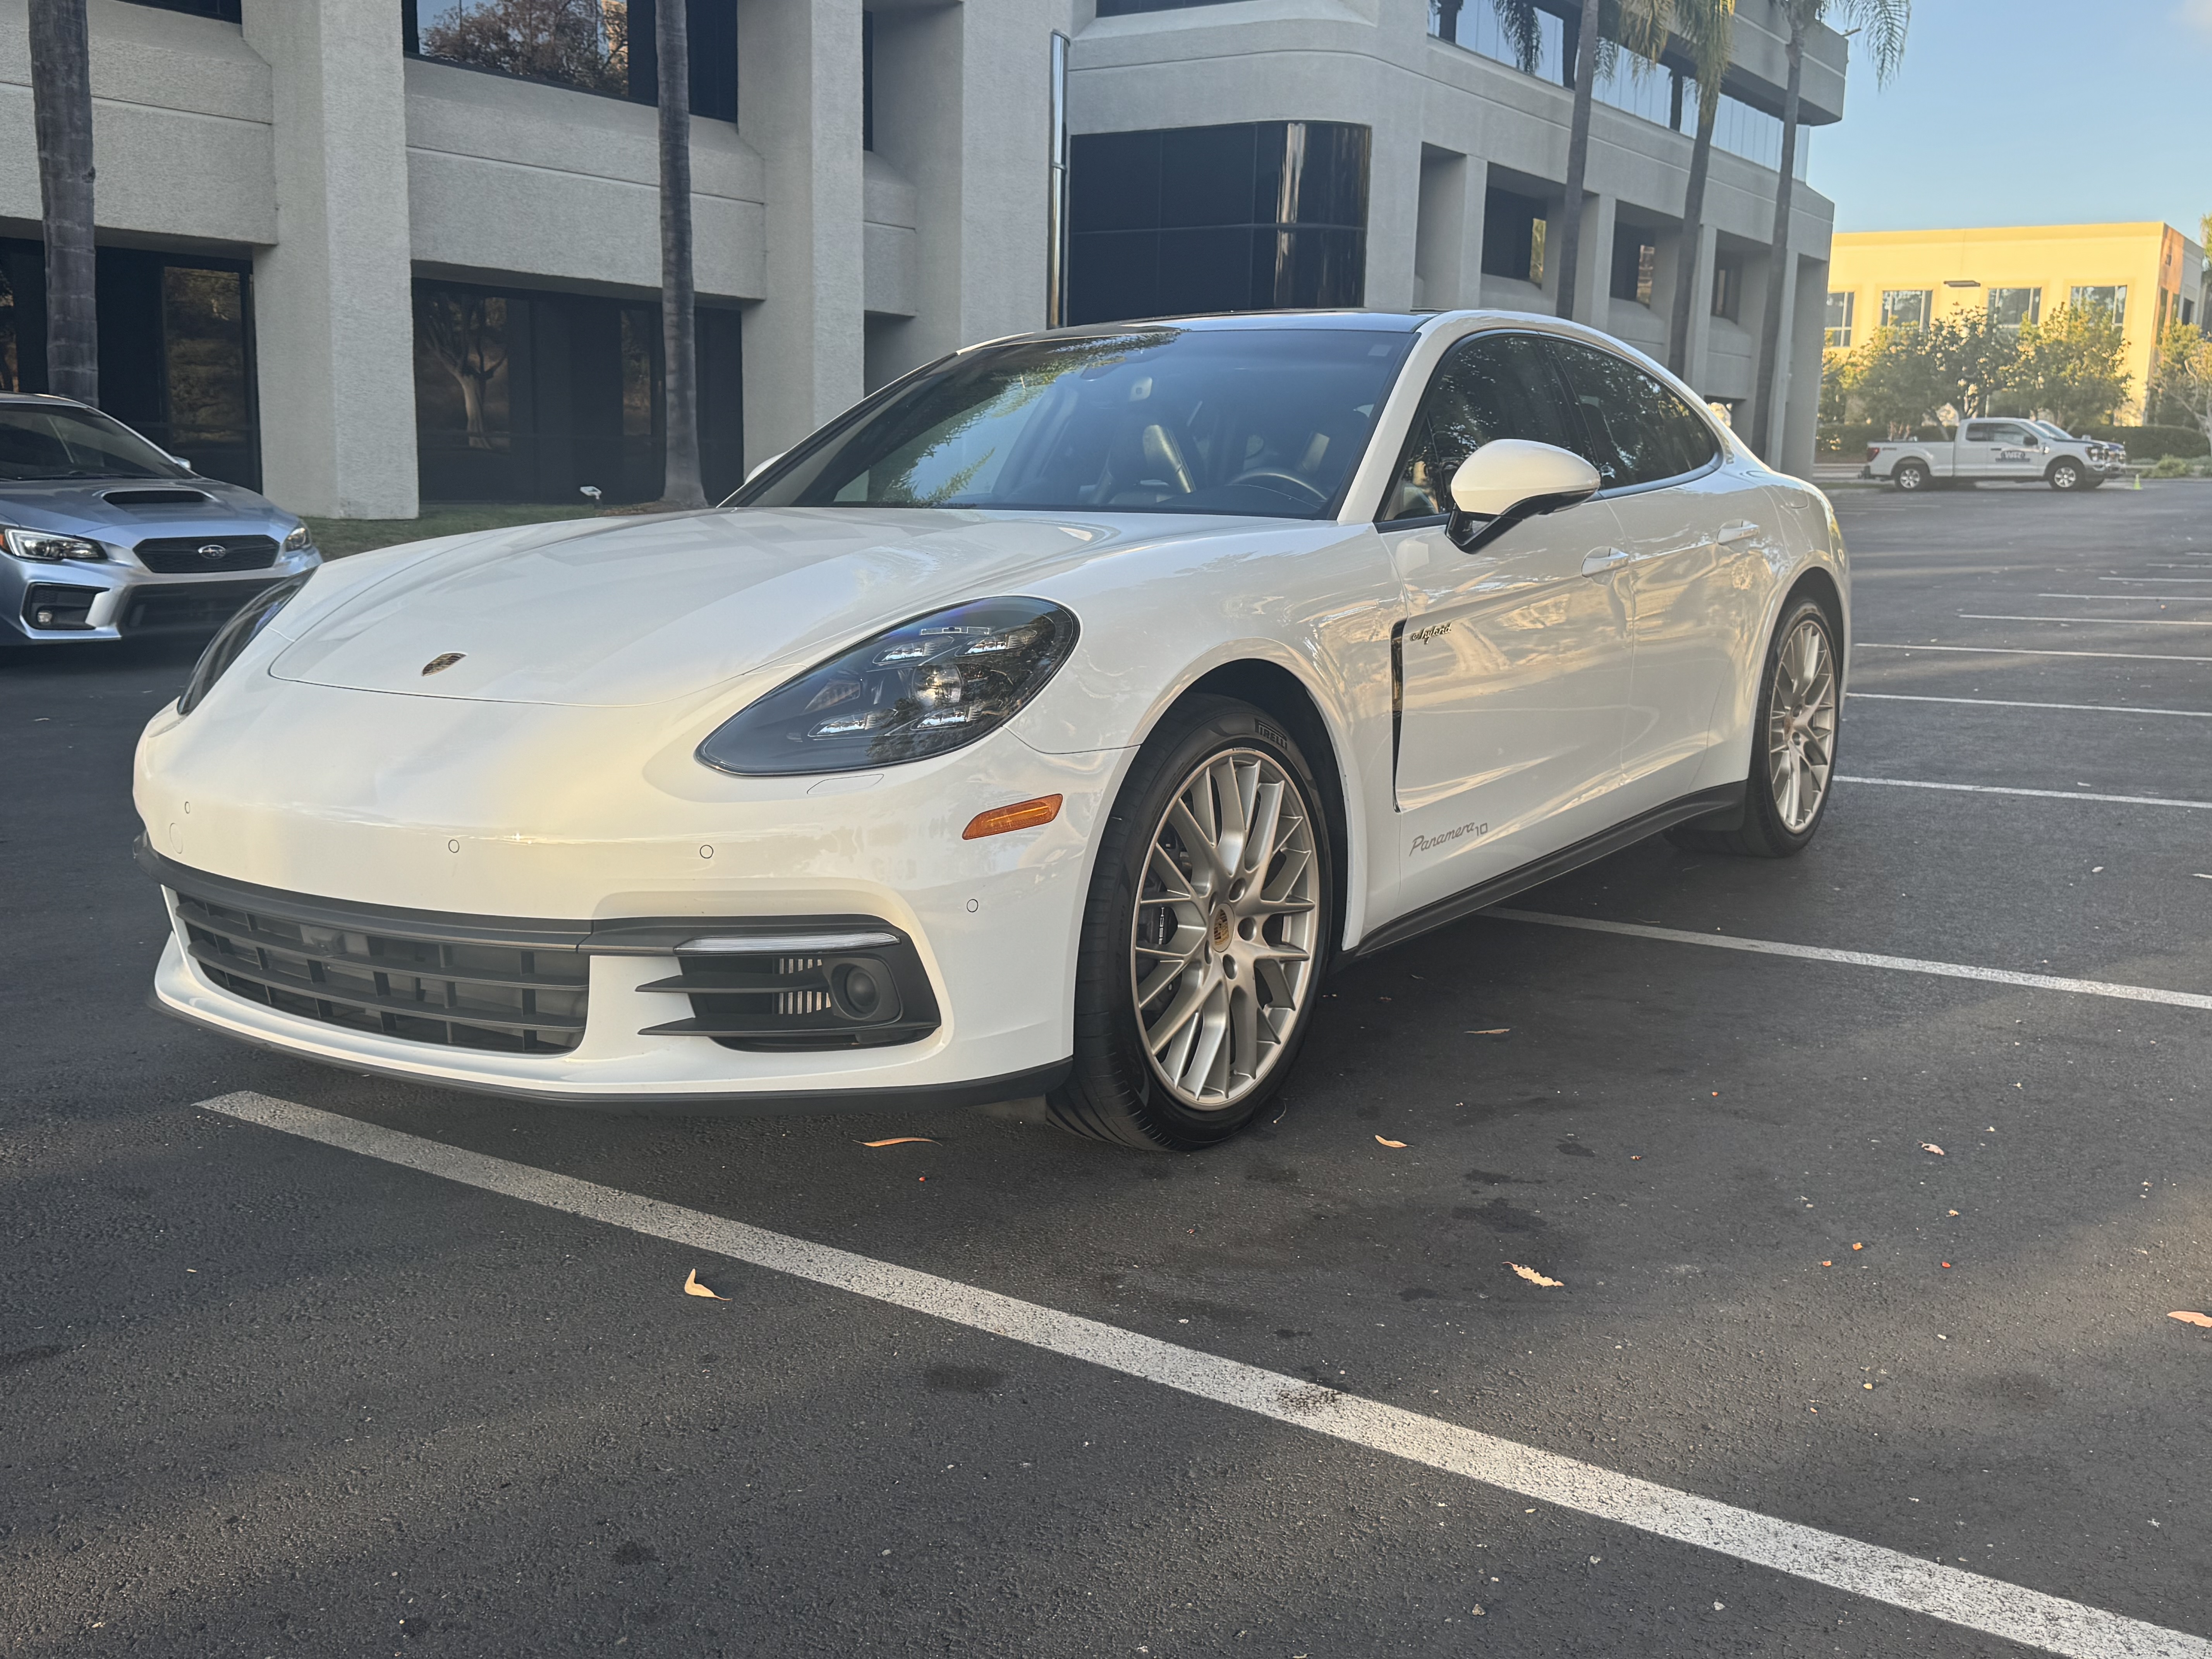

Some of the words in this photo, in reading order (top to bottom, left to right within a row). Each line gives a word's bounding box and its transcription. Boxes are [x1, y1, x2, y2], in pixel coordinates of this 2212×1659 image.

[1254, 718, 1288, 750] PIRELLI
[1409, 822, 1475, 857] Panamera
[1475, 823, 1488, 836] 10
